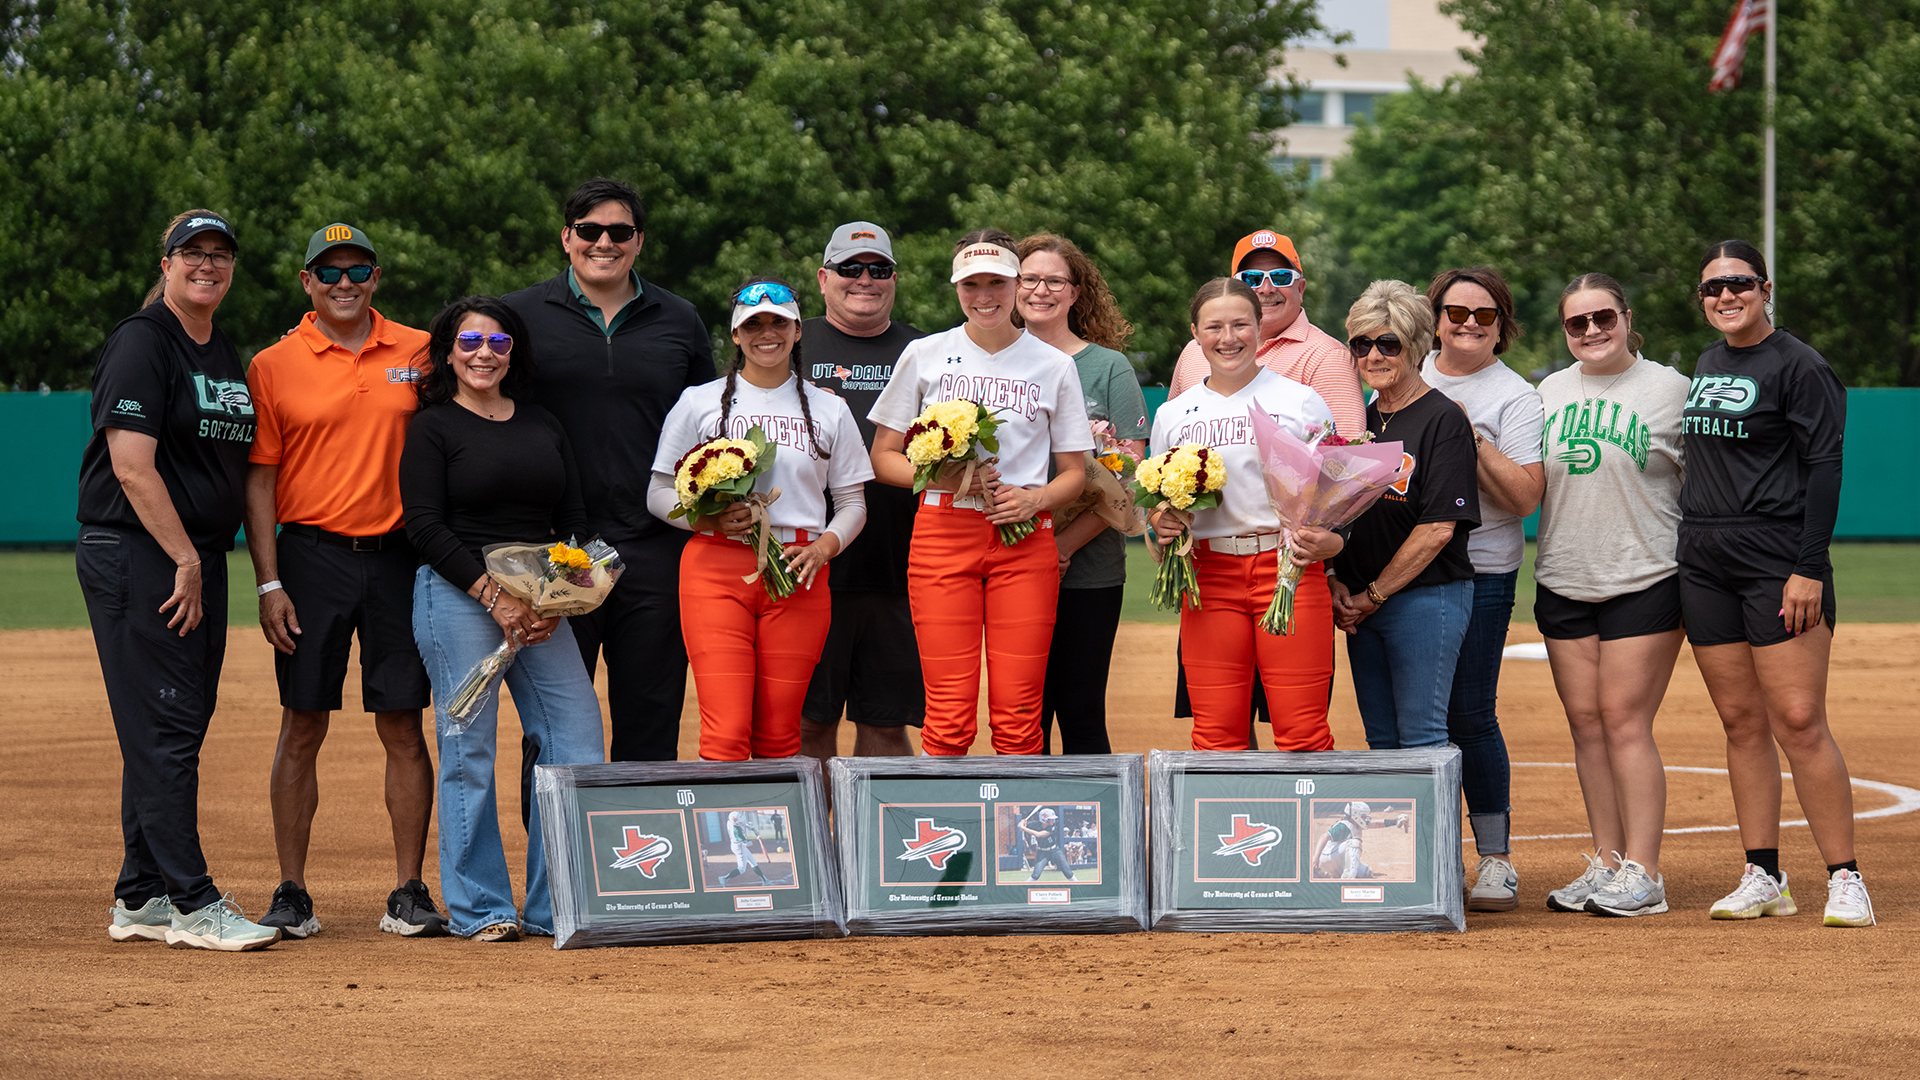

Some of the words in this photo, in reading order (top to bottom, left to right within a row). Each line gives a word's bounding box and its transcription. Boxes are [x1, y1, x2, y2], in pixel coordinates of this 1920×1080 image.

[326, 226, 353, 242] UTD
[1255, 233, 1274, 245] UTD
[964, 251, 973, 259] UT
[812, 363, 834, 379] UT
[852, 365, 892, 380] DALL
[842, 381, 885, 391] SOFTBALL
[192, 373, 256, 416] UTD
[937, 373, 1041, 422] COMETS
[116, 399, 138, 411] LSC
[198, 419, 257, 443] SOFTBAL
[1557, 398, 1652, 473] DALLAS
[980, 783, 999, 801] UTD
[1295, 779, 1315, 796] UTD
[677, 789, 695, 806] UTD
[889, 894, 900, 902] The
[900, 894, 929, 902] University
[961, 893, 978, 901] Dallas
[1215, 890, 1243, 899] University
[1274, 890, 1292, 898] Dallas
[606, 903, 616, 911] The
[616, 903, 644, 911] University
[651, 902, 667, 910] Texas
